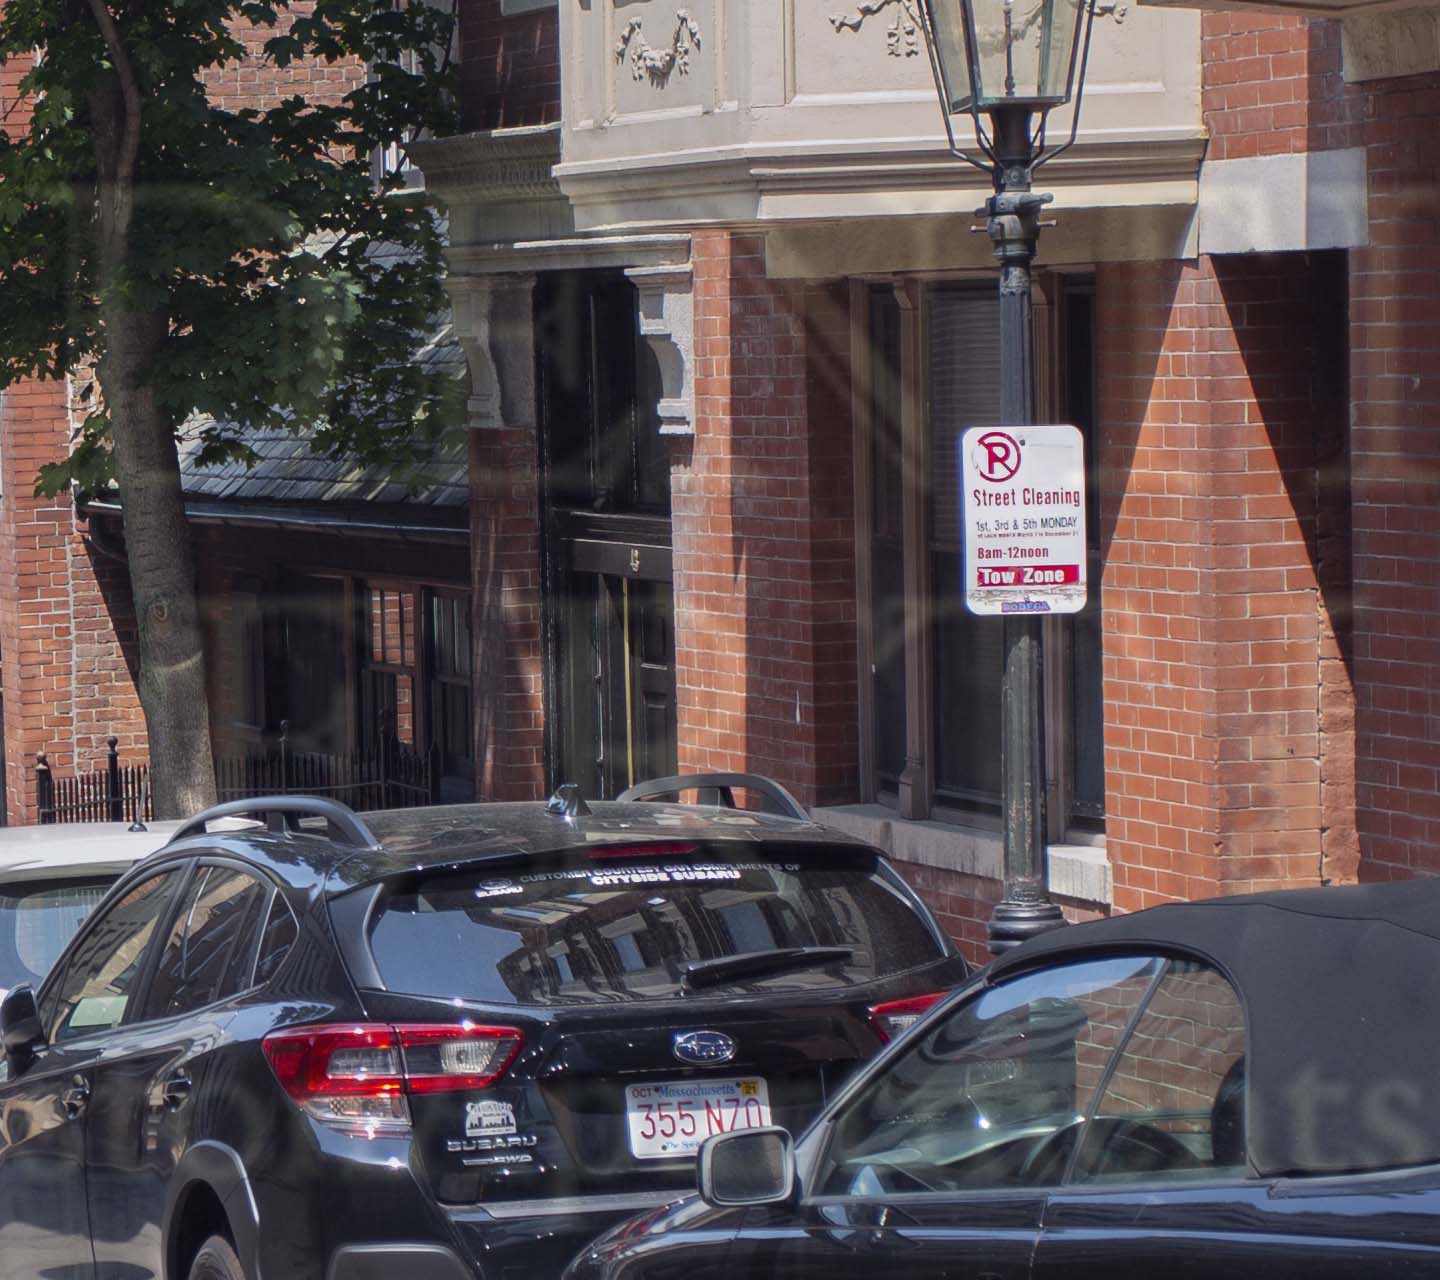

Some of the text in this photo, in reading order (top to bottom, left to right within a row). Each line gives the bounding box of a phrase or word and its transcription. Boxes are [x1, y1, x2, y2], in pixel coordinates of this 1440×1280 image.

[973, 487, 1080, 508] Street Cleaning
[994, 519, 1010, 531] 3rd
[1013, 518, 1020, 530] &
[1023, 517, 1038, 529] 5th
[1040, 516, 1078, 529] MONDAY
[977, 546, 1049, 560] 8am-12noon
[980, 567, 1065, 585] Tow Zone
[520, 869, 592, 883] CUSTOMER
[694, 863, 782, 871] COMPLIMENTS
[590, 869, 742, 886] CITYSIDE SUBARU
[631, 1087, 652, 1098] OCT
[659, 1084, 736, 1098] Massachusetts
[637, 1100, 697, 1140] 355
[447, 1135, 538, 1152] SUBARU
